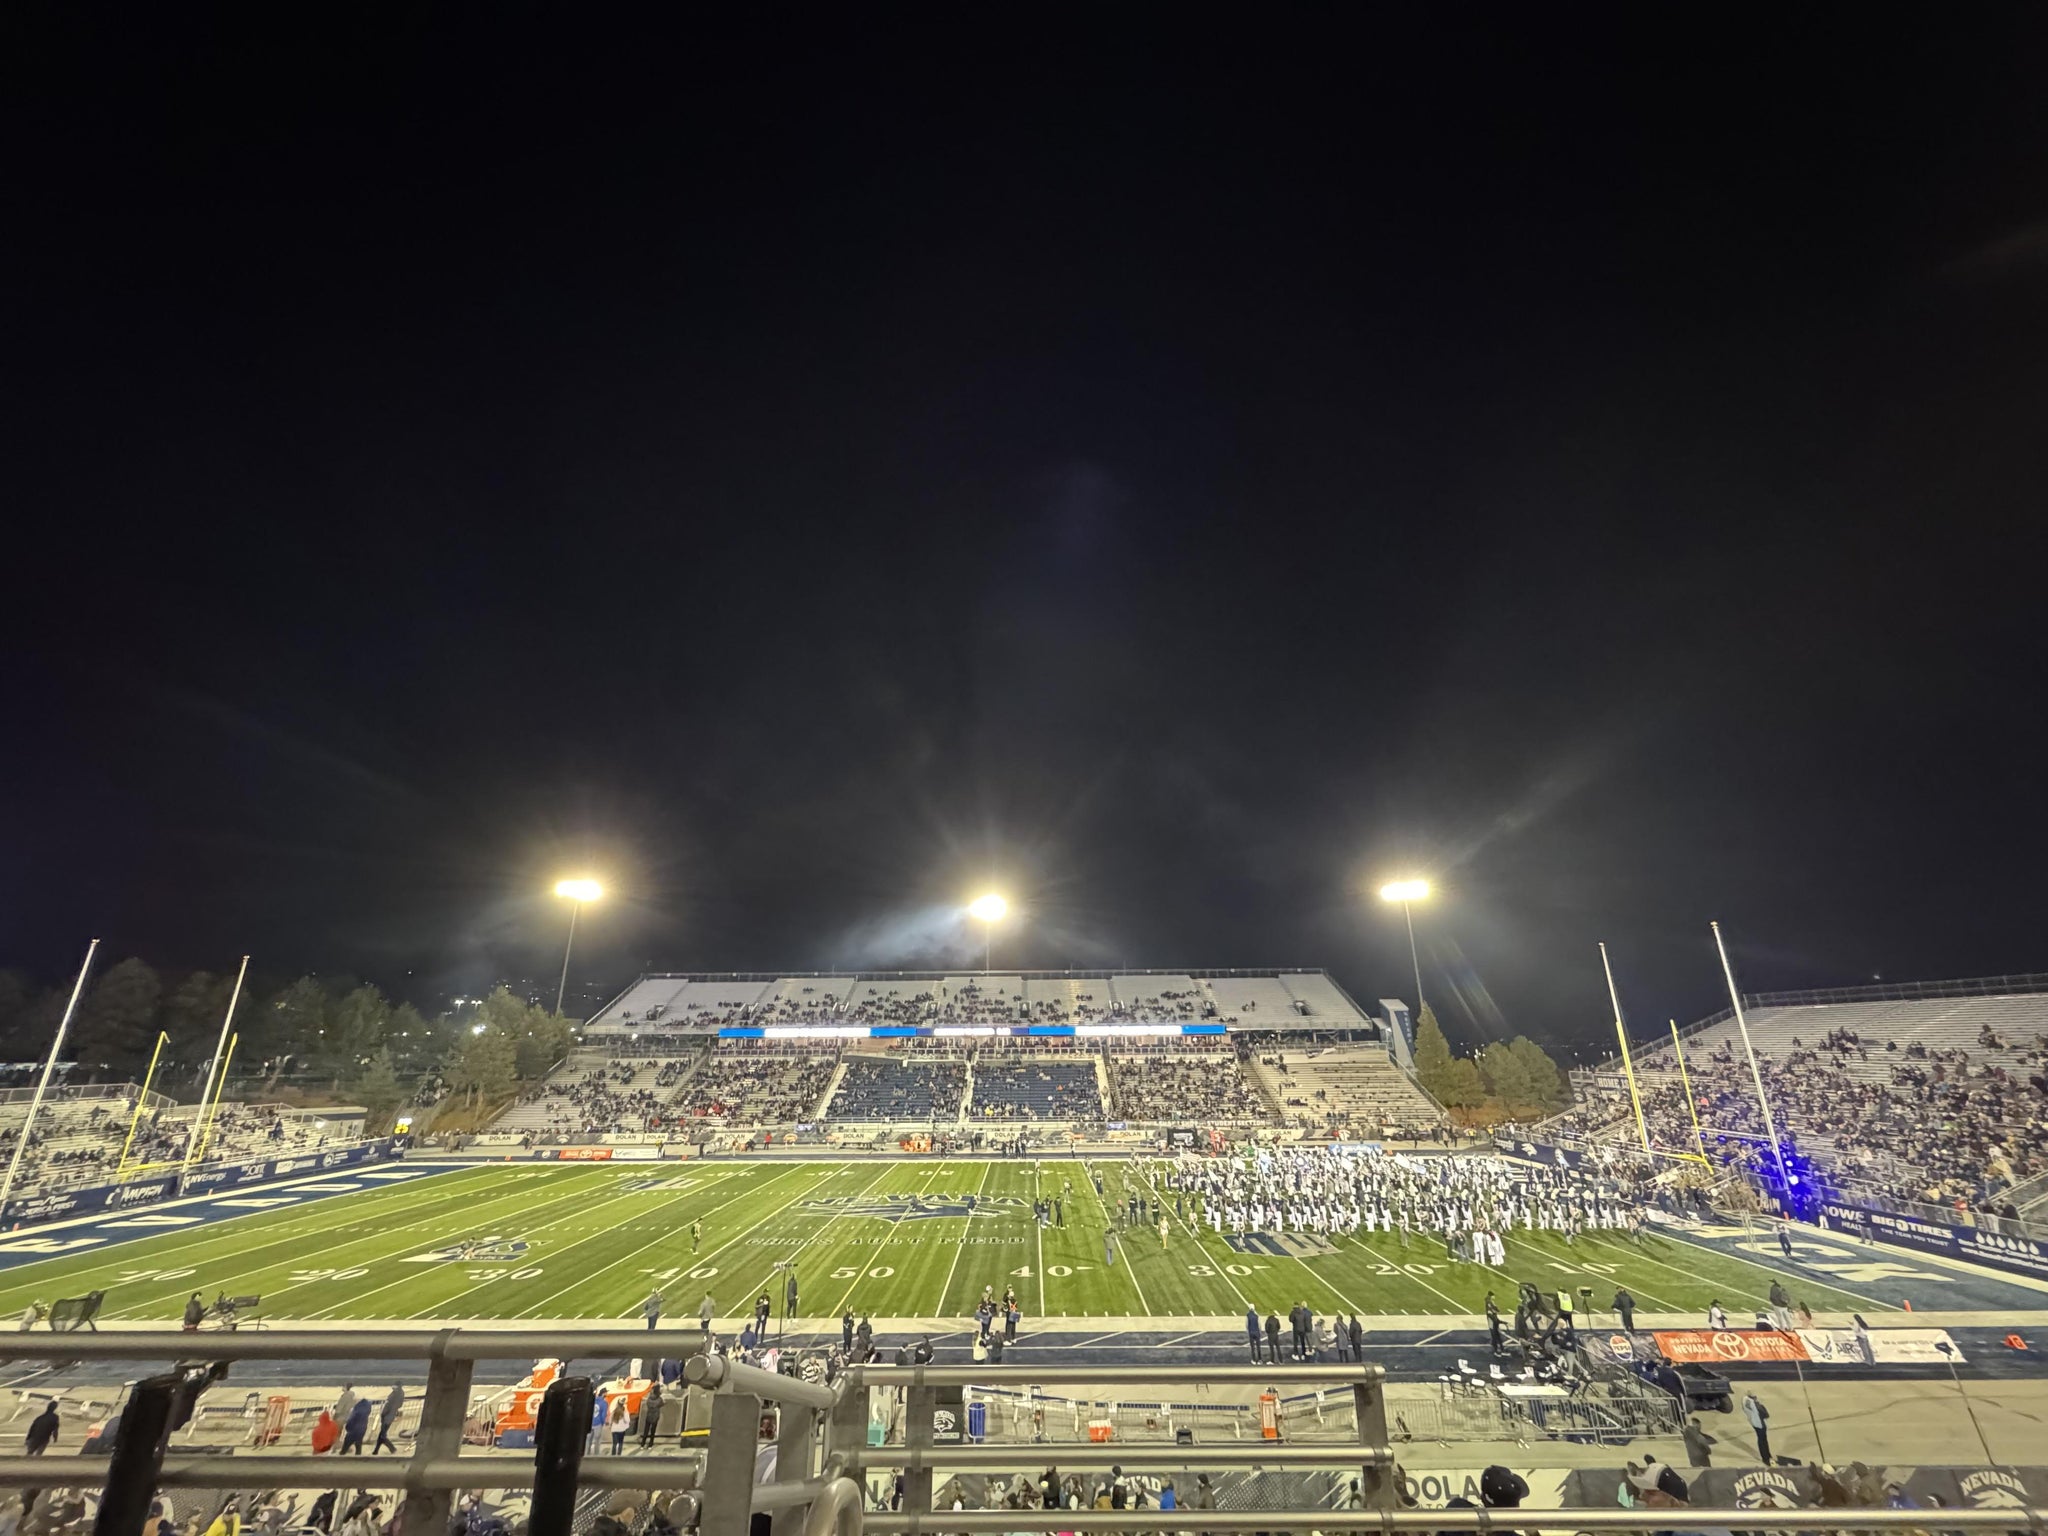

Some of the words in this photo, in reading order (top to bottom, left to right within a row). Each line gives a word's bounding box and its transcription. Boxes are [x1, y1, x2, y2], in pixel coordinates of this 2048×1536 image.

[1871, 1215, 1896, 1227] BIG
[1909, 1220, 1955, 1240] TIRES
[468, 1269, 544, 1280] 30
[651, 1267, 719, 1279] 40
[830, 1267, 895, 1279] 50
[1010, 1265, 1073, 1277] 40
[1188, 1264, 1252, 1276] 30
[1366, 1263, 1434, 1275] 20
[1748, 1337, 1785, 1346] TOYOTA
[1672, 1344, 1712, 1354] NEVADA
[1404, 1475, 1483, 1501] DOLA
[1734, 1472, 1800, 1497] NEVADA
[1960, 1471, 2029, 1497] NEVADA
